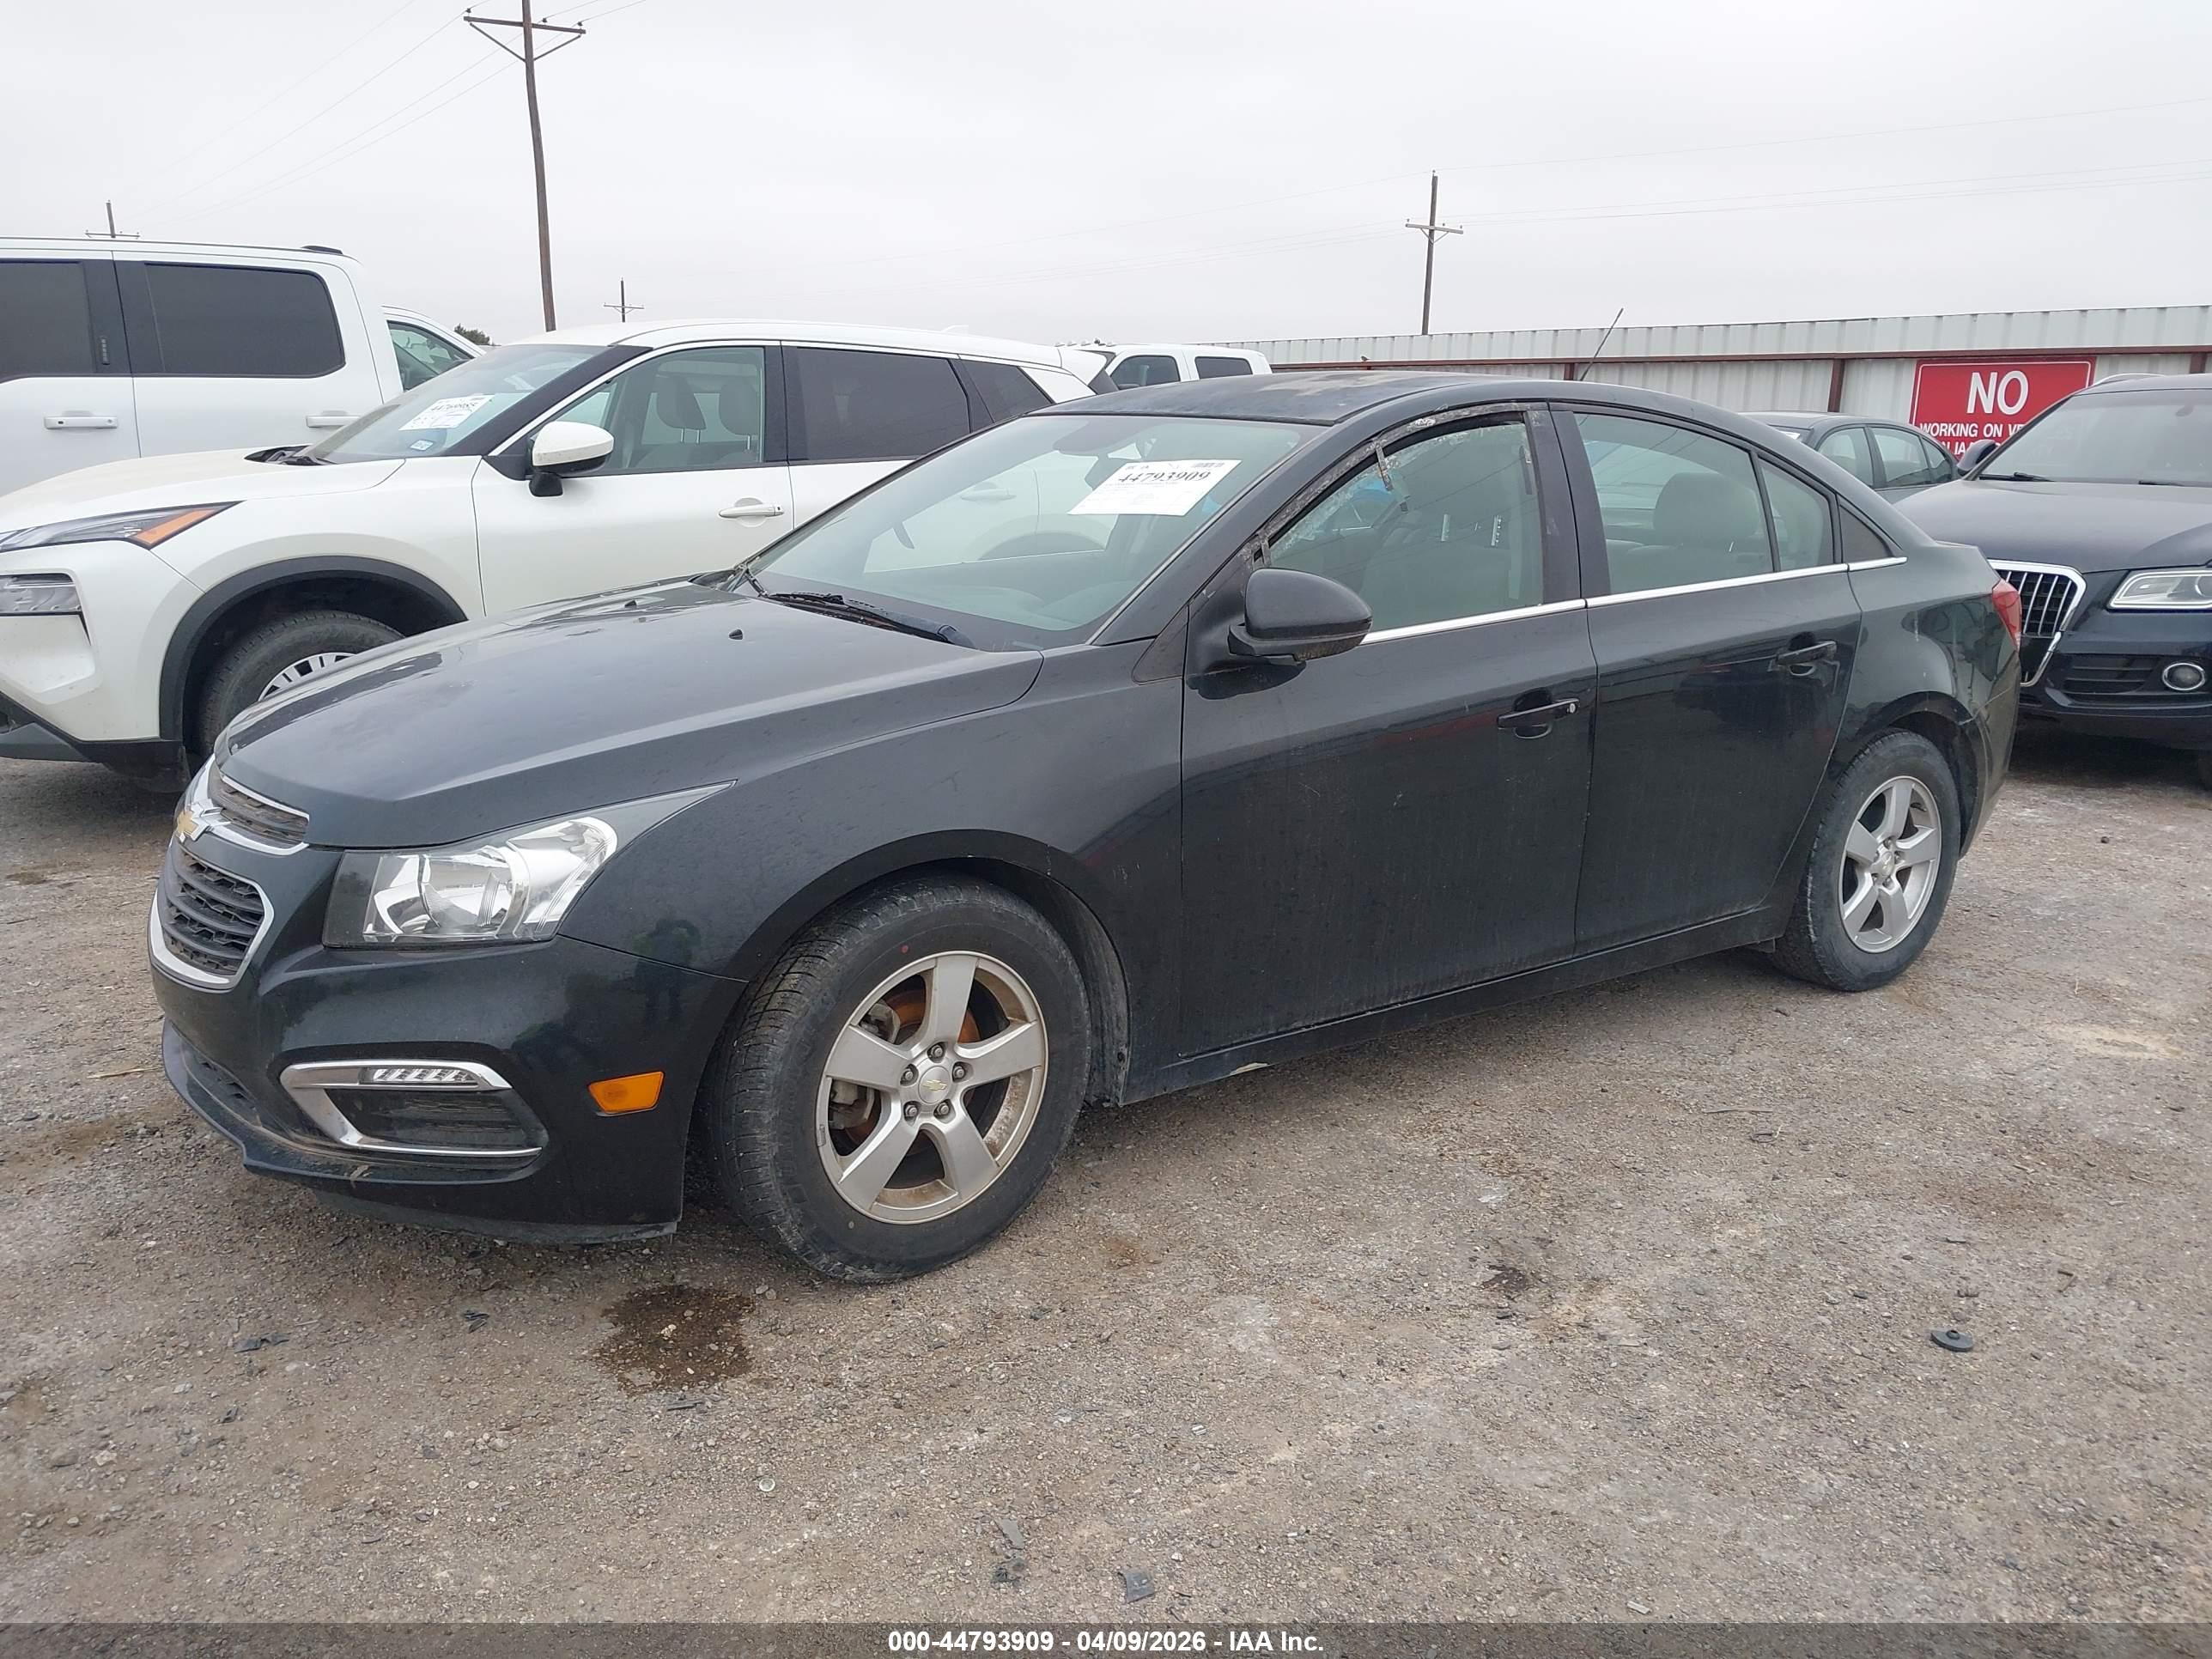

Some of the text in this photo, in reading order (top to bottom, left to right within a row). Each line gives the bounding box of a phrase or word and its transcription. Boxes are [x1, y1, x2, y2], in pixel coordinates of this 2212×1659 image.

[1966, 370, 2029, 416] NO
[1919, 422, 1978, 437] WORKING
[1983, 423, 2003, 437] ON
[1118, 471, 1212, 483] 44793909
